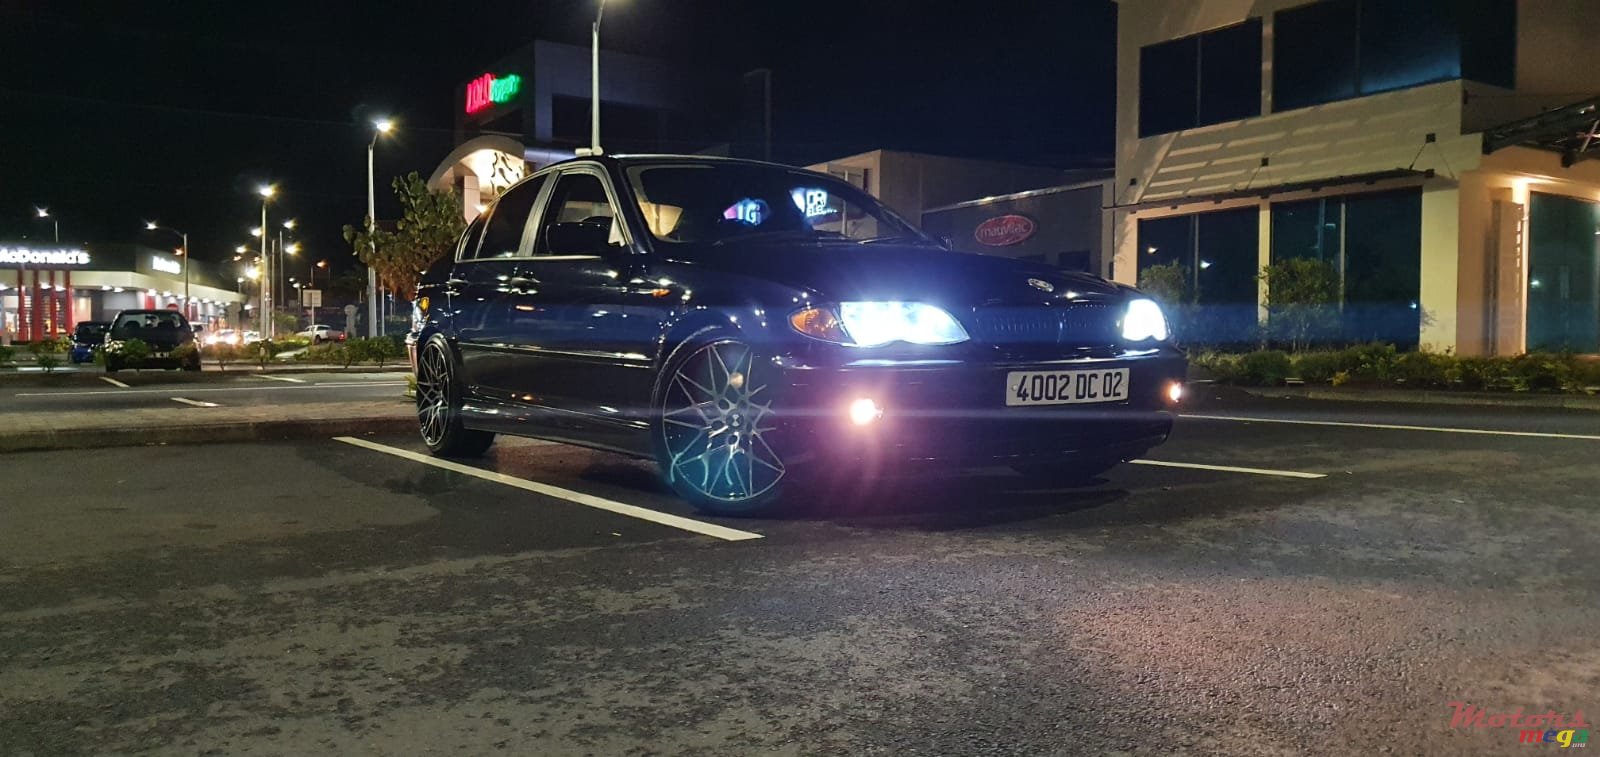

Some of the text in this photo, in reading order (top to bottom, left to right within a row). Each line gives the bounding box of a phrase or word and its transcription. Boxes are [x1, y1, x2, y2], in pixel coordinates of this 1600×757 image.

[1017, 372, 1122, 401] 4002 DC 02
